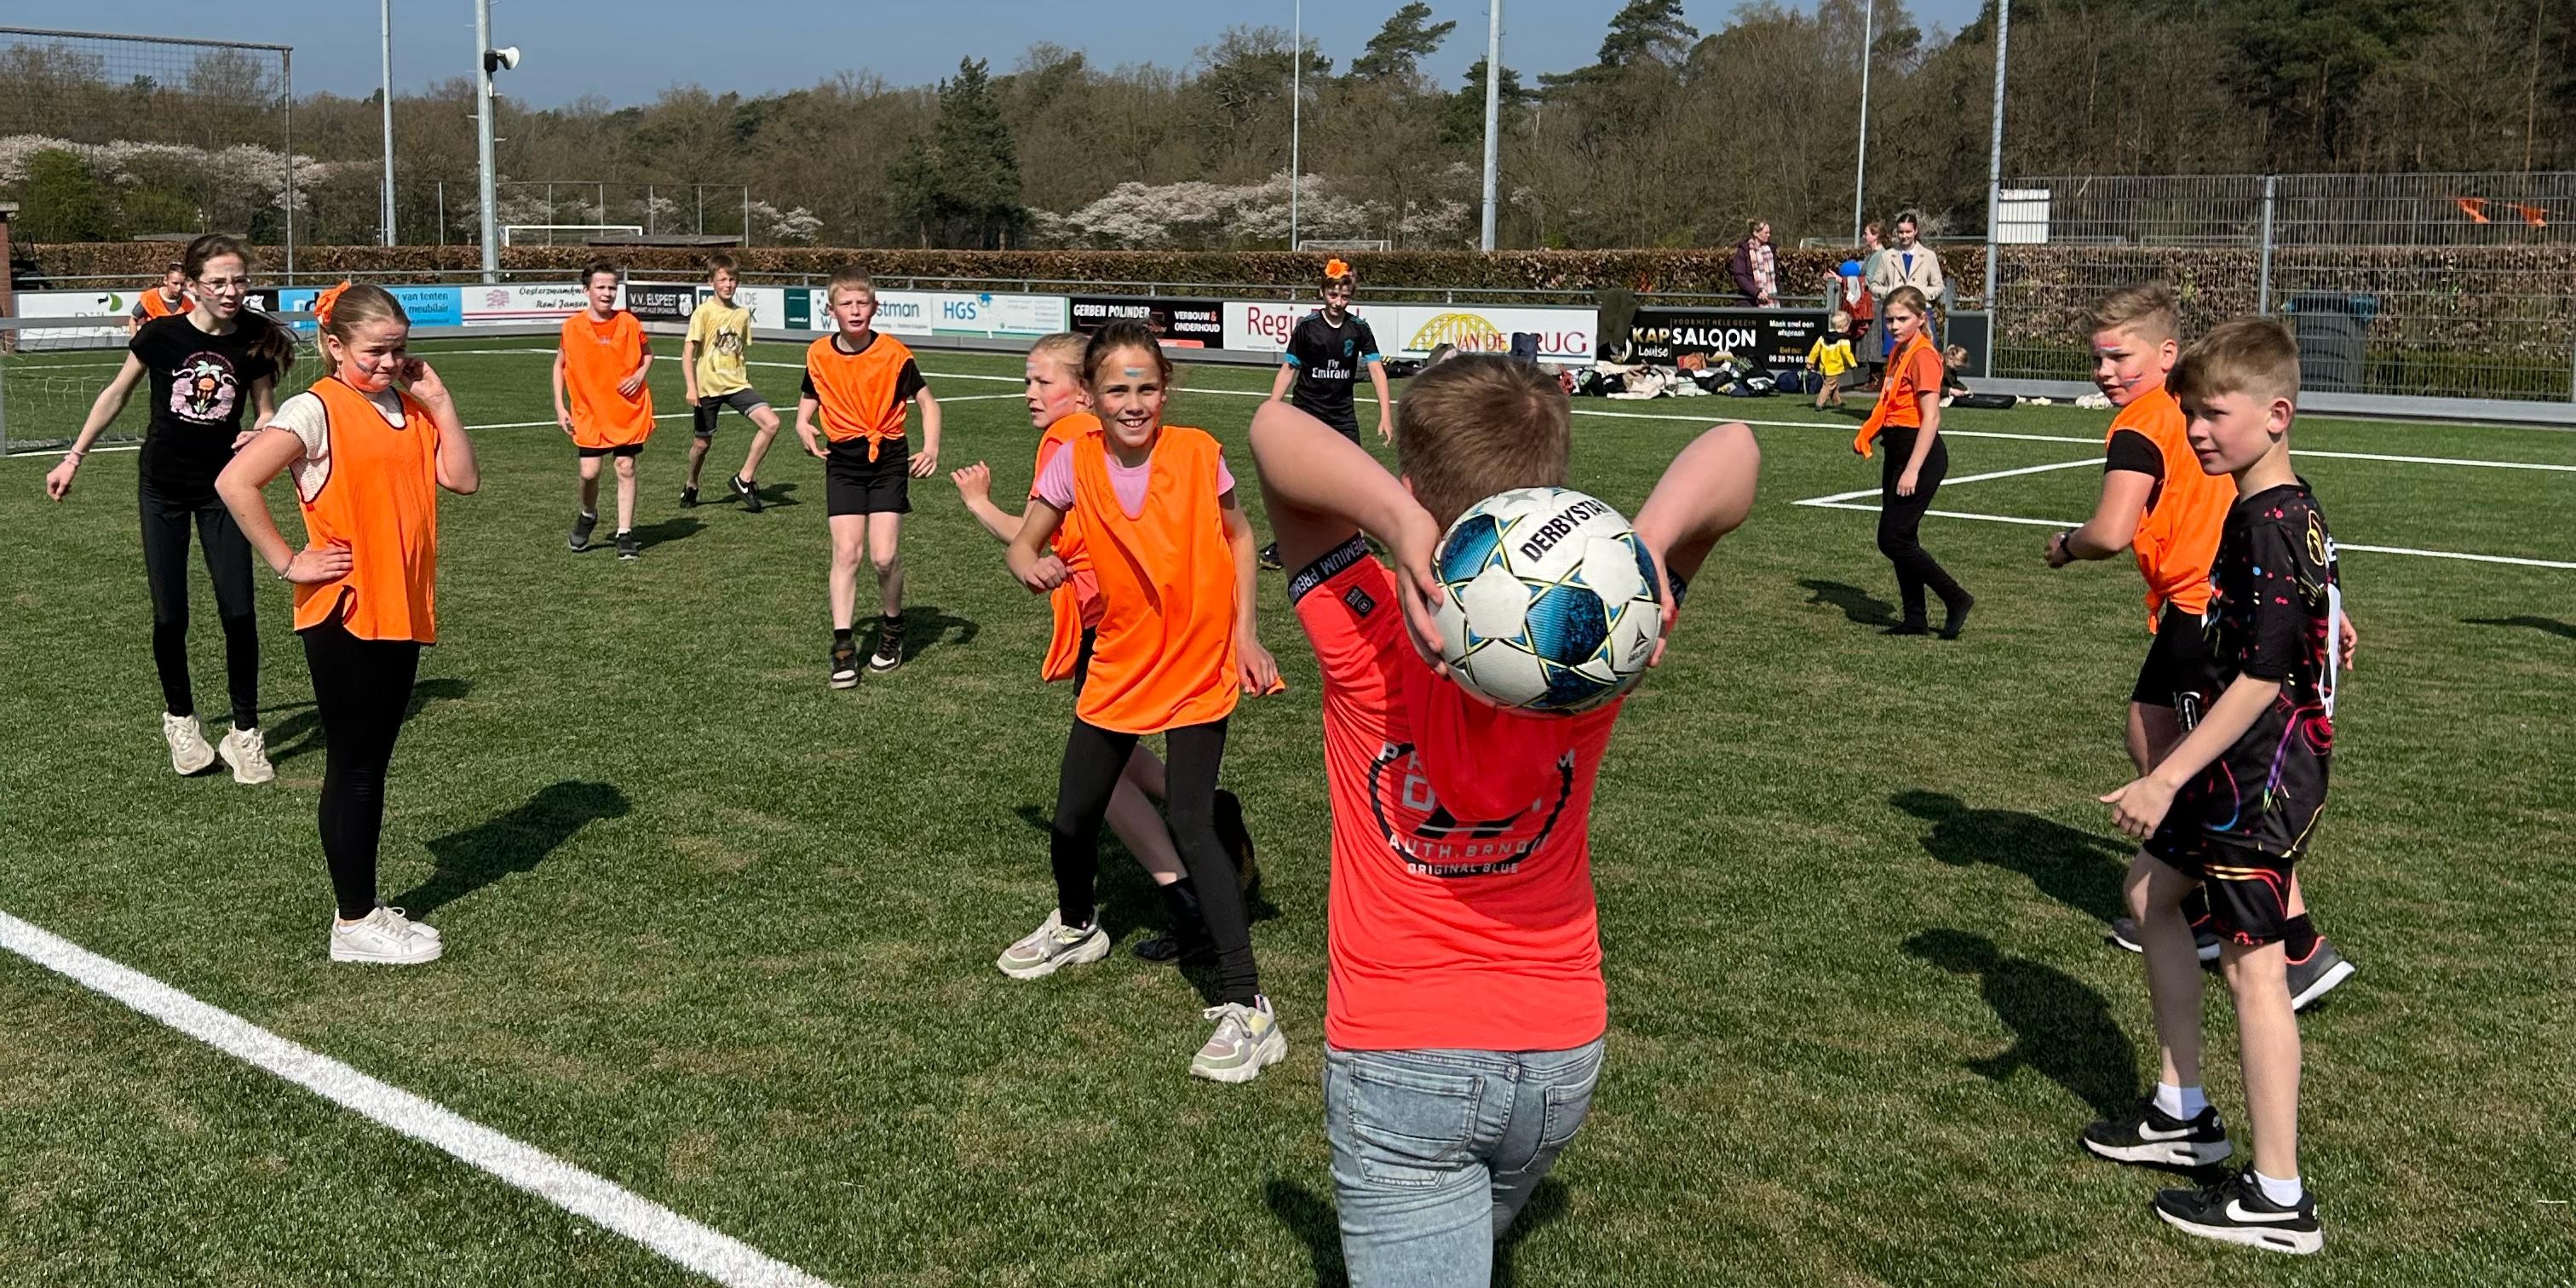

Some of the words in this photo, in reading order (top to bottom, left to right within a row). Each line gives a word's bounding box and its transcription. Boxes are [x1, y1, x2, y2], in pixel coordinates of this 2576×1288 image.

[420, 291, 449, 301] tenten
[647, 293, 676, 307] ELSPEET
[877, 301, 919, 318] stman
[943, 301, 976, 320] HGS
[1073, 304, 1106, 319] GERBEN
[1174, 310, 1210, 321] VERBOUW
[1210, 311, 1217, 322] &
[1174, 322, 1221, 333] ONDERHOUD
[1454, 332, 1480, 351] VAN
[1486, 332, 1508, 351] DE
[1531, 331, 1587, 354] RUG
[1632, 327, 1670, 343] KAP
[1672, 327, 1757, 348] SALOON
[1638, 344, 1669, 358] Louise
[1327, 359, 1340, 370] Fly
[1519, 499, 1613, 563] DERBYSTAR
[1407, 862, 1477, 877] ORIGINAL
[1482, 862, 1519, 875] BLUE
